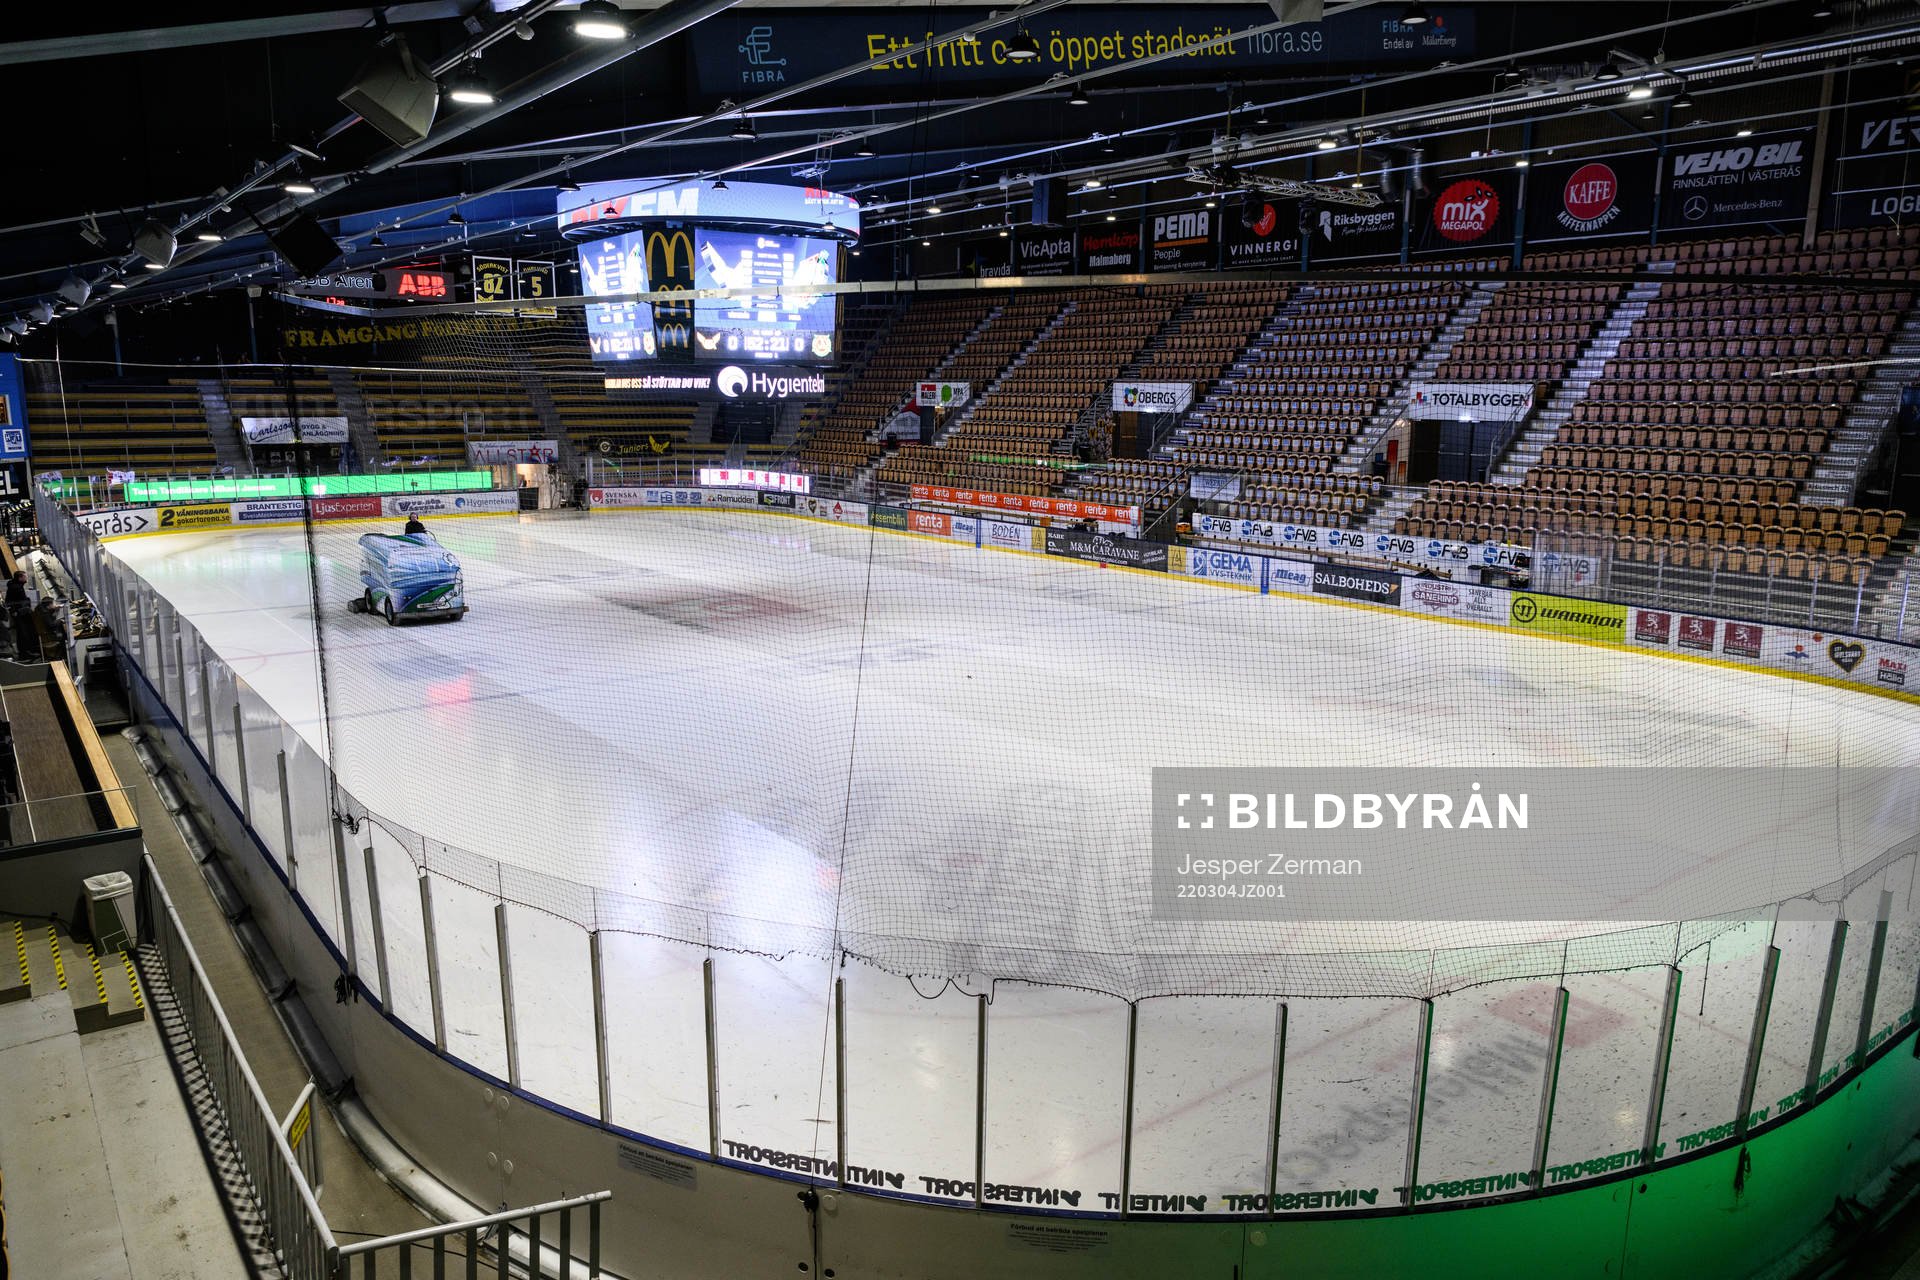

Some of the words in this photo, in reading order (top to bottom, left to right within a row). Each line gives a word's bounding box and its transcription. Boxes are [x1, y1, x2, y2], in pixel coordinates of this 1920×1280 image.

[867, 34, 917, 70] Ett
[924, 31, 984, 67] fritt
[1050, 30, 1125, 70] öppet
[1131, 26, 1236, 58] stadsnät
[1247, 24, 1323, 54] fibra.se
[742, 70, 785, 83] FIBRA
[1674, 146, 1755, 177] VEHO
[1753, 141, 1804, 167] BIL
[1673, 173, 1738, 190] FINNSLÄTTEN
[1749, 166, 1801, 182] VÄSTERÅS
[1569, 180, 1611, 204] KAFFE
[1713, 199, 1783, 213] Mercedes-Benz
[1154, 211, 1209, 241] PEMA
[1333, 211, 1395, 227] Riksbyggen
[1440, 221, 1485, 231] MEGAPOL
[1556, 205, 1622, 232] KAFFEKNAPPEN
[1020, 238, 1071, 258] VicApta
[1154, 248, 1181, 260] People
[1229, 239, 1298, 257] VINNERGI
[1089, 253, 1132, 268] Malmaberg
[980, 263, 1011, 277] bravida
[335, 274, 375, 288] Aren
[398, 273, 446, 296] ABB
[483, 273, 504, 295] 82
[531, 276, 542, 297] 5
[283, 321, 418, 348] FRAMGÅNG
[642, 376, 651, 389] SÅ
[651, 376, 681, 389] STÖTTAR
[681, 378, 693, 389] DU
[1138, 390, 1176, 405] ÖBERGS
[1431, 392, 1531, 407] TOTALBYGGEN
[316, 500, 374, 514] LjusExperten
[467, 496, 516, 508] Hygienteknik
[717, 494, 755, 504] Ramudden
[913, 485, 928, 495] renta
[932, 488, 950, 498] renta
[955, 491, 973, 501] renta
[978, 493, 997, 503] renta
[1003, 496, 1022, 506] renta
[1029, 499, 1049, 509] renta
[1056, 502, 1077, 512] renta
[1085, 504, 1107, 516] renta
[1115, 508, 1132, 519] rent
[160, 509, 175, 527] 2
[176, 507, 230, 517] VÅNINGSBANA
[871, 512, 906, 526] Assemblin
[85, 512, 132, 537] terås
[176, 515, 230, 526] gokartarena.se
[915, 513, 943, 529] renta
[992, 524, 1021, 539] BODEN
[1212, 520, 1232, 532] FVB
[1295, 528, 1317, 542] FVB
[1339, 533, 1364, 548] FVB
[1389, 538, 1415, 554] FVB
[1070, 541, 1092, 554] M&M
[1092, 545, 1139, 560] CARAVANE
[1210, 552, 1252, 574] GEMA
[1210, 569, 1252, 582] VVS-TEKNIK
[1314, 572, 1390, 595] SALBOHEDS
[1414, 591, 1458, 604] SANERING
[1541, 607, 1624, 629] WARRIOR
